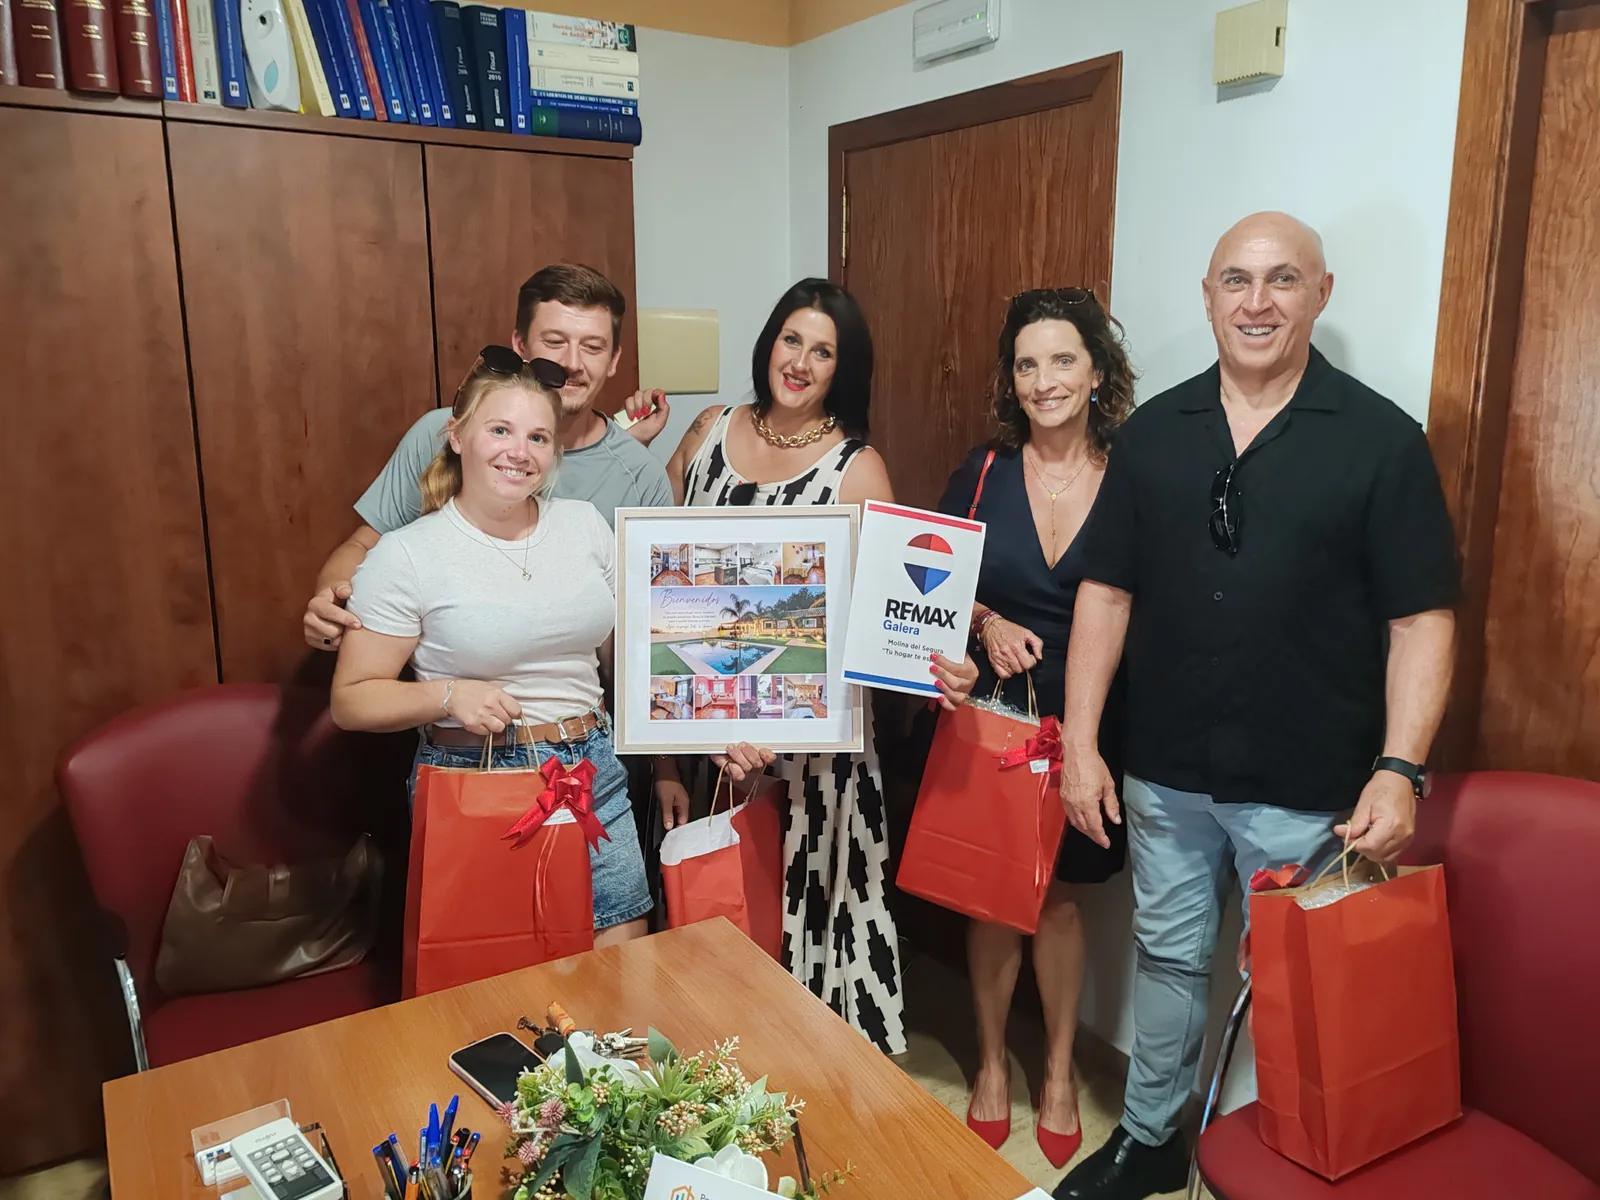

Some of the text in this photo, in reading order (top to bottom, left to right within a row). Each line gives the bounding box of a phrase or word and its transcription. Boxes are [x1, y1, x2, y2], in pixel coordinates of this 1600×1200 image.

[660, 589, 720, 608] Bienvenidos
[883, 619, 920, 636] Galera
[887, 639, 909, 648] Molina
[922, 645, 944, 655] Segura
[894, 650, 913, 659] hogar
